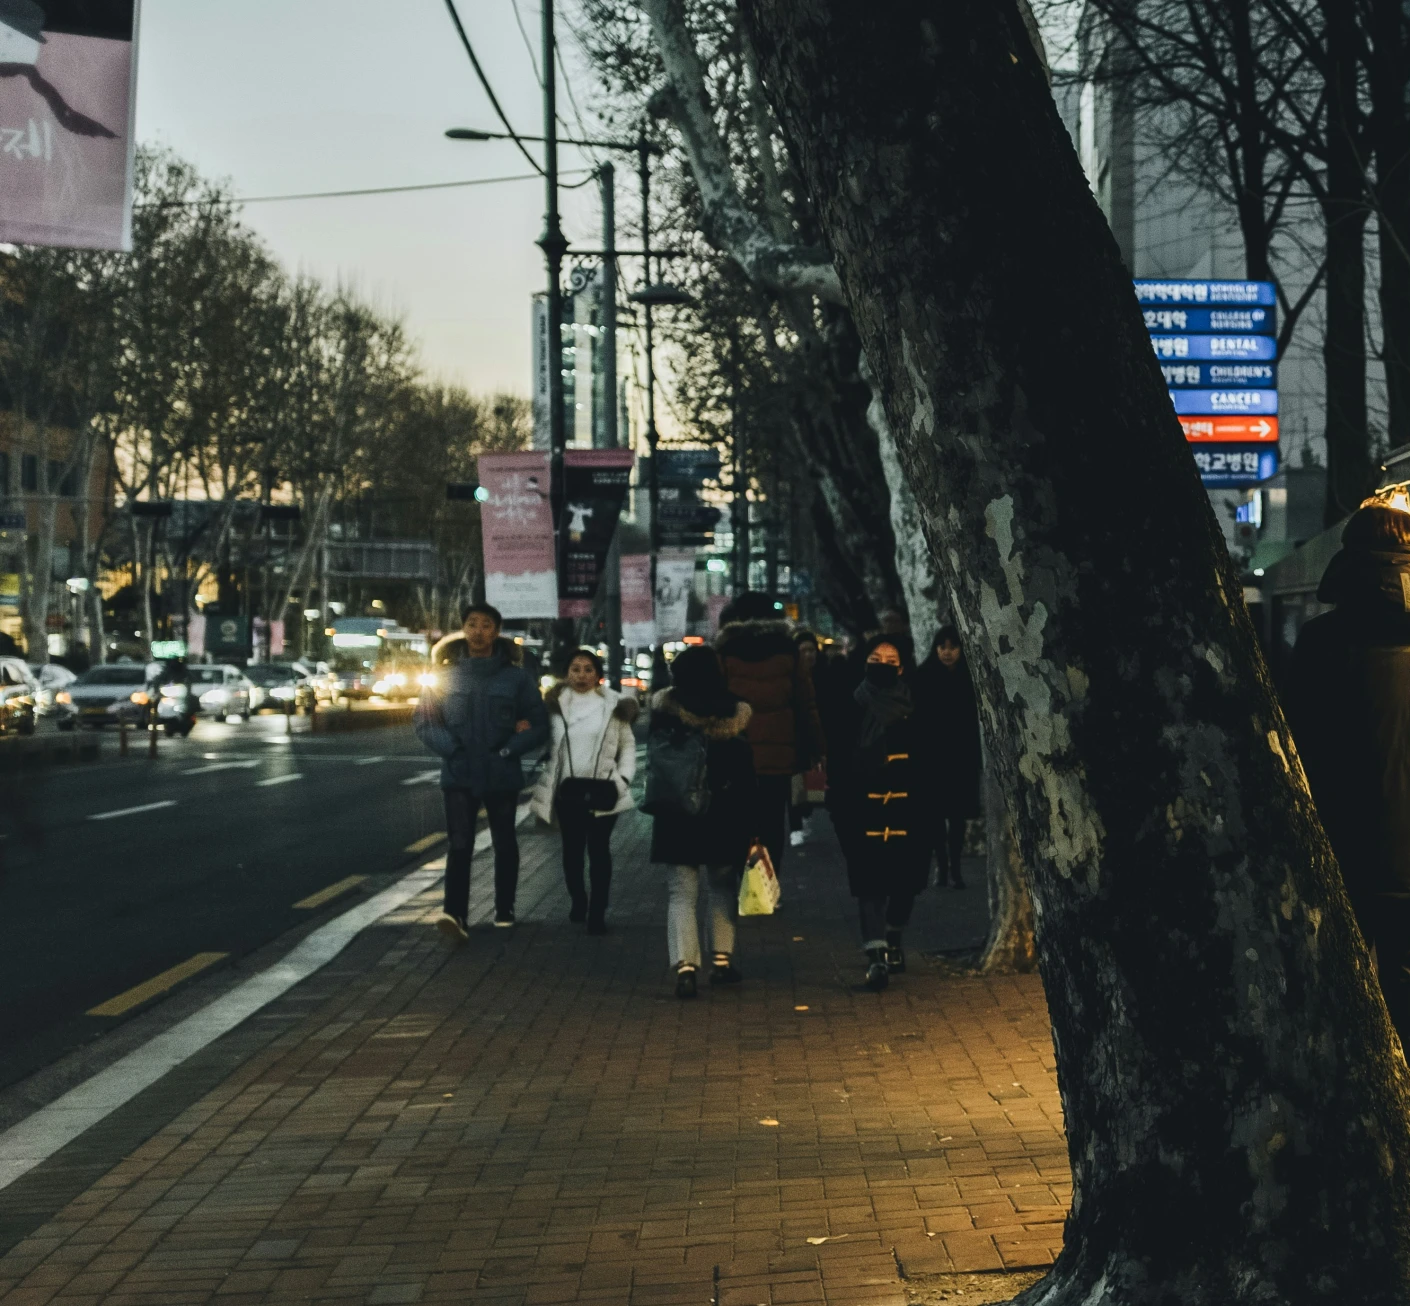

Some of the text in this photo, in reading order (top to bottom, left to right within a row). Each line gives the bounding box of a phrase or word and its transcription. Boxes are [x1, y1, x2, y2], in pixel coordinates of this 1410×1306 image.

[1151, 338, 1188, 357] 병원
[1210, 338, 1258, 351] DENTAL
[1210, 365, 1272, 378] CHILDREN'S
[1210, 392, 1261, 405] CANCER
